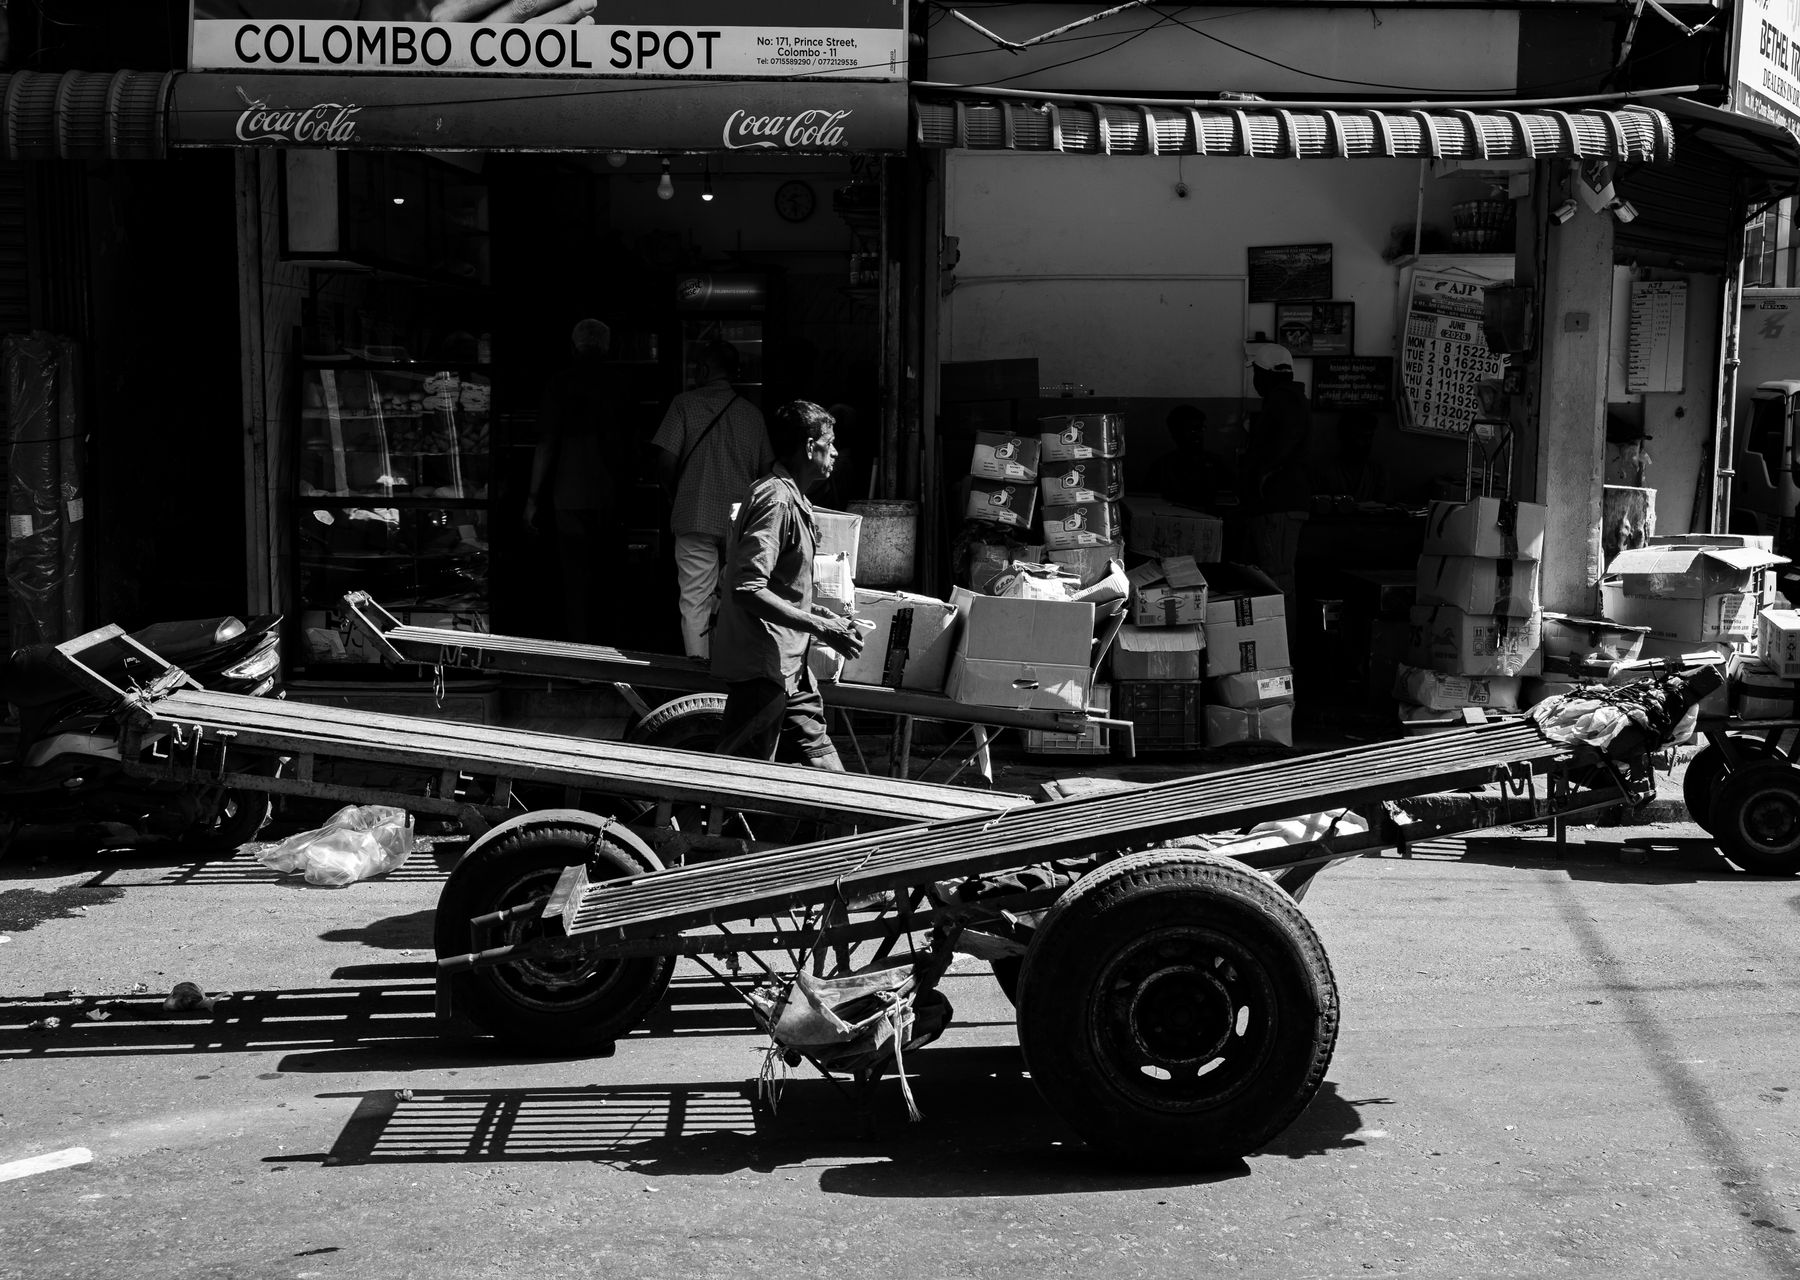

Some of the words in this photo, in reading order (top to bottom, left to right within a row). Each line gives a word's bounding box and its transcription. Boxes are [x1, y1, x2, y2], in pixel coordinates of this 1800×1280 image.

[235, 24, 452, 66] COLOMBO
[470, 27, 592, 69] COOL
[609, 30, 721, 70] SPOT
[757, 37, 773, 46] No:
[776, 37, 791, 48] 171,
[794, 37, 823, 46] Prince
[826, 38, 857, 49] Street,
[777, 47, 820, 57] Colombo
[830, 48, 837, 57] 11
[1760, 18, 1788, 71] BETHEL
[756, 57, 768, 65] Tel:
[817, 58, 858, 66] 0772129536
[1763, 68, 1787, 100] DEALERS
[235, 102, 362, 142] Coca-Cola
[723, 109, 853, 149] Coca-Cola
[1449, 282, 1477, 296] AJP
[1445, 330, 1467, 341] 2026
[1449, 321, 1466, 331] JUNE
[1408, 336, 1425, 348] MON
[1430, 341, 1436, 351] 1
[1444, 342, 1451, 354] 8
[1456, 345, 1470, 356] 15
[1472, 348, 1485, 359] 22
[1406, 362, 1423, 373] WED
[1427, 364, 1434, 375] 3
[1439, 367, 1452, 378] 10
[1454, 369, 1466, 381] 17
[1407, 350, 1424, 361] TUE
[1429, 352, 1435, 363] 2
[1443, 355, 1450, 366] 9
[1455, 357, 1468, 369] 16
[1470, 360, 1483, 372] 23
[1485, 362, 1498, 374] 30
[1405, 374, 1422, 385] THU
[1426, 377, 1433, 388] 4
[1438, 380, 1450, 391] 11
[1451, 383, 1464, 394] 18
[1425, 389, 1432, 400] 5
[1436, 392, 1450, 403] 12
[1451, 394, 1464, 406] 19
[1465, 397, 1478, 409] 26
[1423, 402, 1430, 413] 6
[1435, 404, 1448, 416] 13
[1449, 407, 1462, 419] 20
[1422, 415, 1428, 426] 7
[1434, 417, 1446, 429] 14
[1449, 419, 1460, 432] 21
